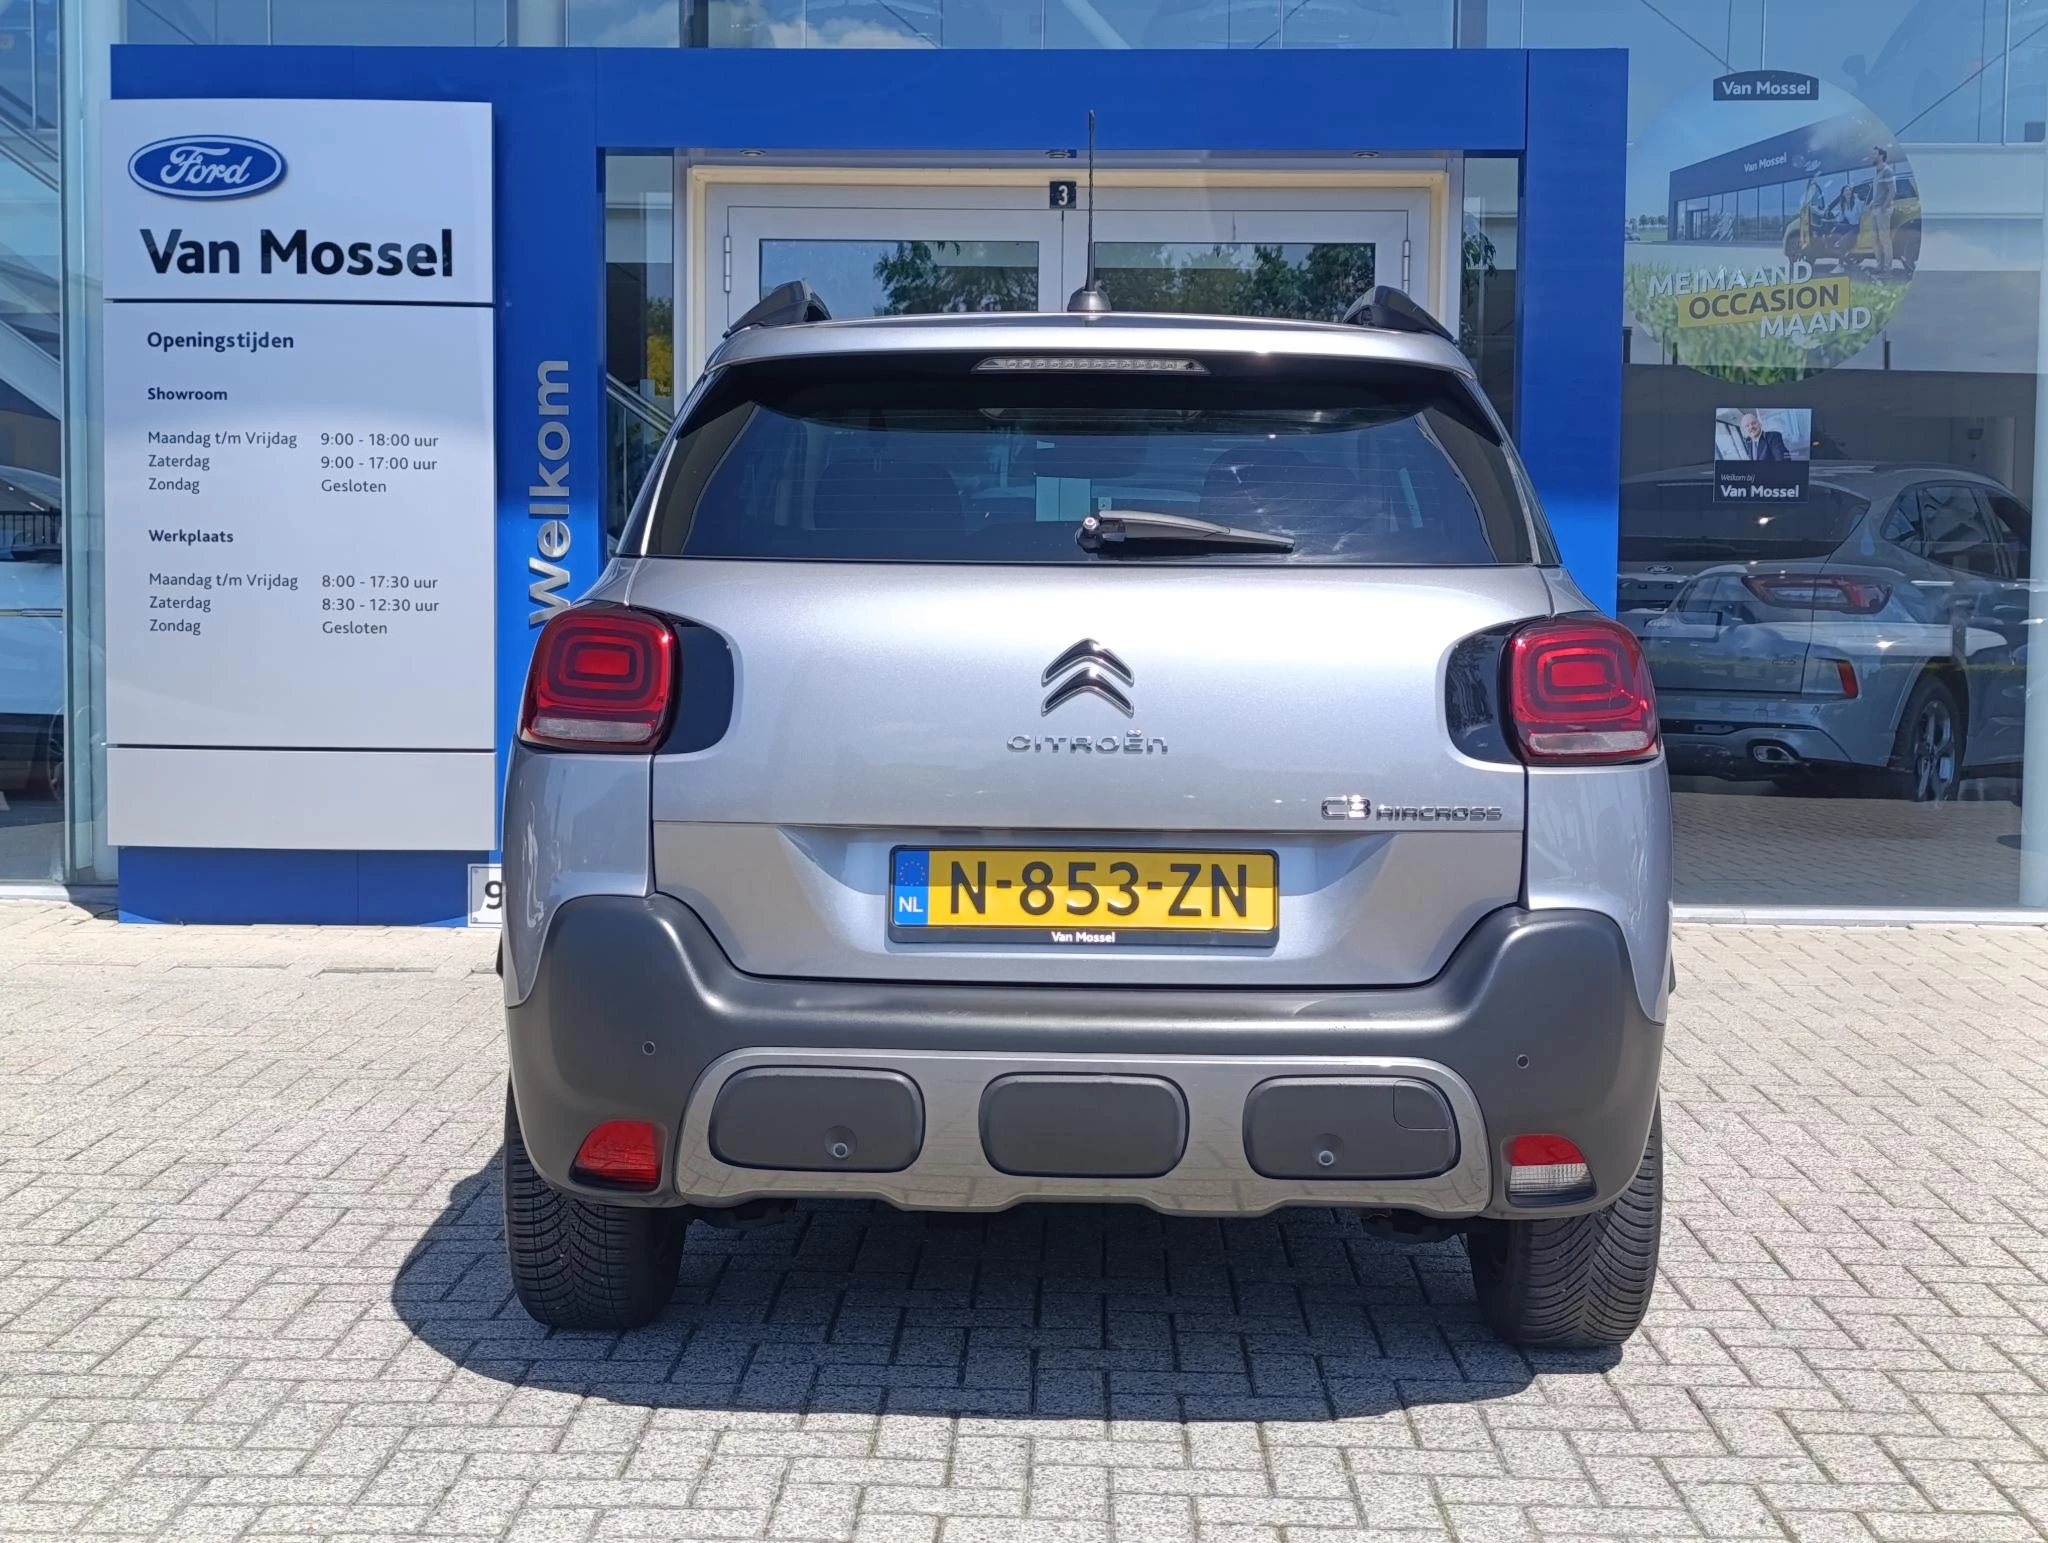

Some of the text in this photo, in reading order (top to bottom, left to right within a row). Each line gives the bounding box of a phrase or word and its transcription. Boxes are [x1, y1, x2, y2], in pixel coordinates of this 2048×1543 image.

[1722, 81, 1811, 95] Van Mossel
[159, 144, 253, 185] Ford
[1744, 152, 1787, 172] Van Mossel
[1058, 184, 1069, 206] 3
[139, 228, 453, 278] Van Mossel
[1650, 260, 1814, 298] MEIMAAND
[1688, 284, 1840, 320] OCCASION
[1759, 306, 1873, 339] MAAND
[147, 331, 294, 353] Openingstijden
[147, 386, 228, 401] Showroom
[148, 430, 212, 449] Maandag
[214, 431, 242, 445] t/m
[244, 431, 298, 449] Vrijdag
[320, 432, 354, 446] 9:00
[368, 432, 410, 447] 18:00
[414, 437, 439, 447] uur
[147, 453, 211, 472] Zaterdag
[320, 455, 354, 469] 9:00
[368, 456, 409, 470] 17:00
[413, 460, 438, 471] uur
[148, 476, 387, 495] Zondag Gesloten
[528, 360, 571, 626] Welkom
[1720, 484, 1800, 497] Van Mossel
[148, 528, 234, 547] Werkplaats
[149, 572, 213, 590] Maandag
[215, 573, 243, 587] t/m
[246, 573, 299, 591] Vrijdag
[321, 574, 355, 588] 8:00
[369, 575, 410, 589] 17:30
[413, 579, 439, 589] uur
[149, 595, 212, 613] Zaterdag
[321, 597, 355, 611] 8:30
[369, 598, 411, 612] 12:30
[415, 602, 440, 612] uur
[149, 618, 388, 637] Zondag Gesloten
[1321, 796, 1503, 821] C3 AIRCROSS
[485, 881, 502, 910] 9
[950, 861, 1247, 918] N-853-ZN
[899, 897, 923, 913] NL
[1051, 931, 1116, 943] Van Mossel
